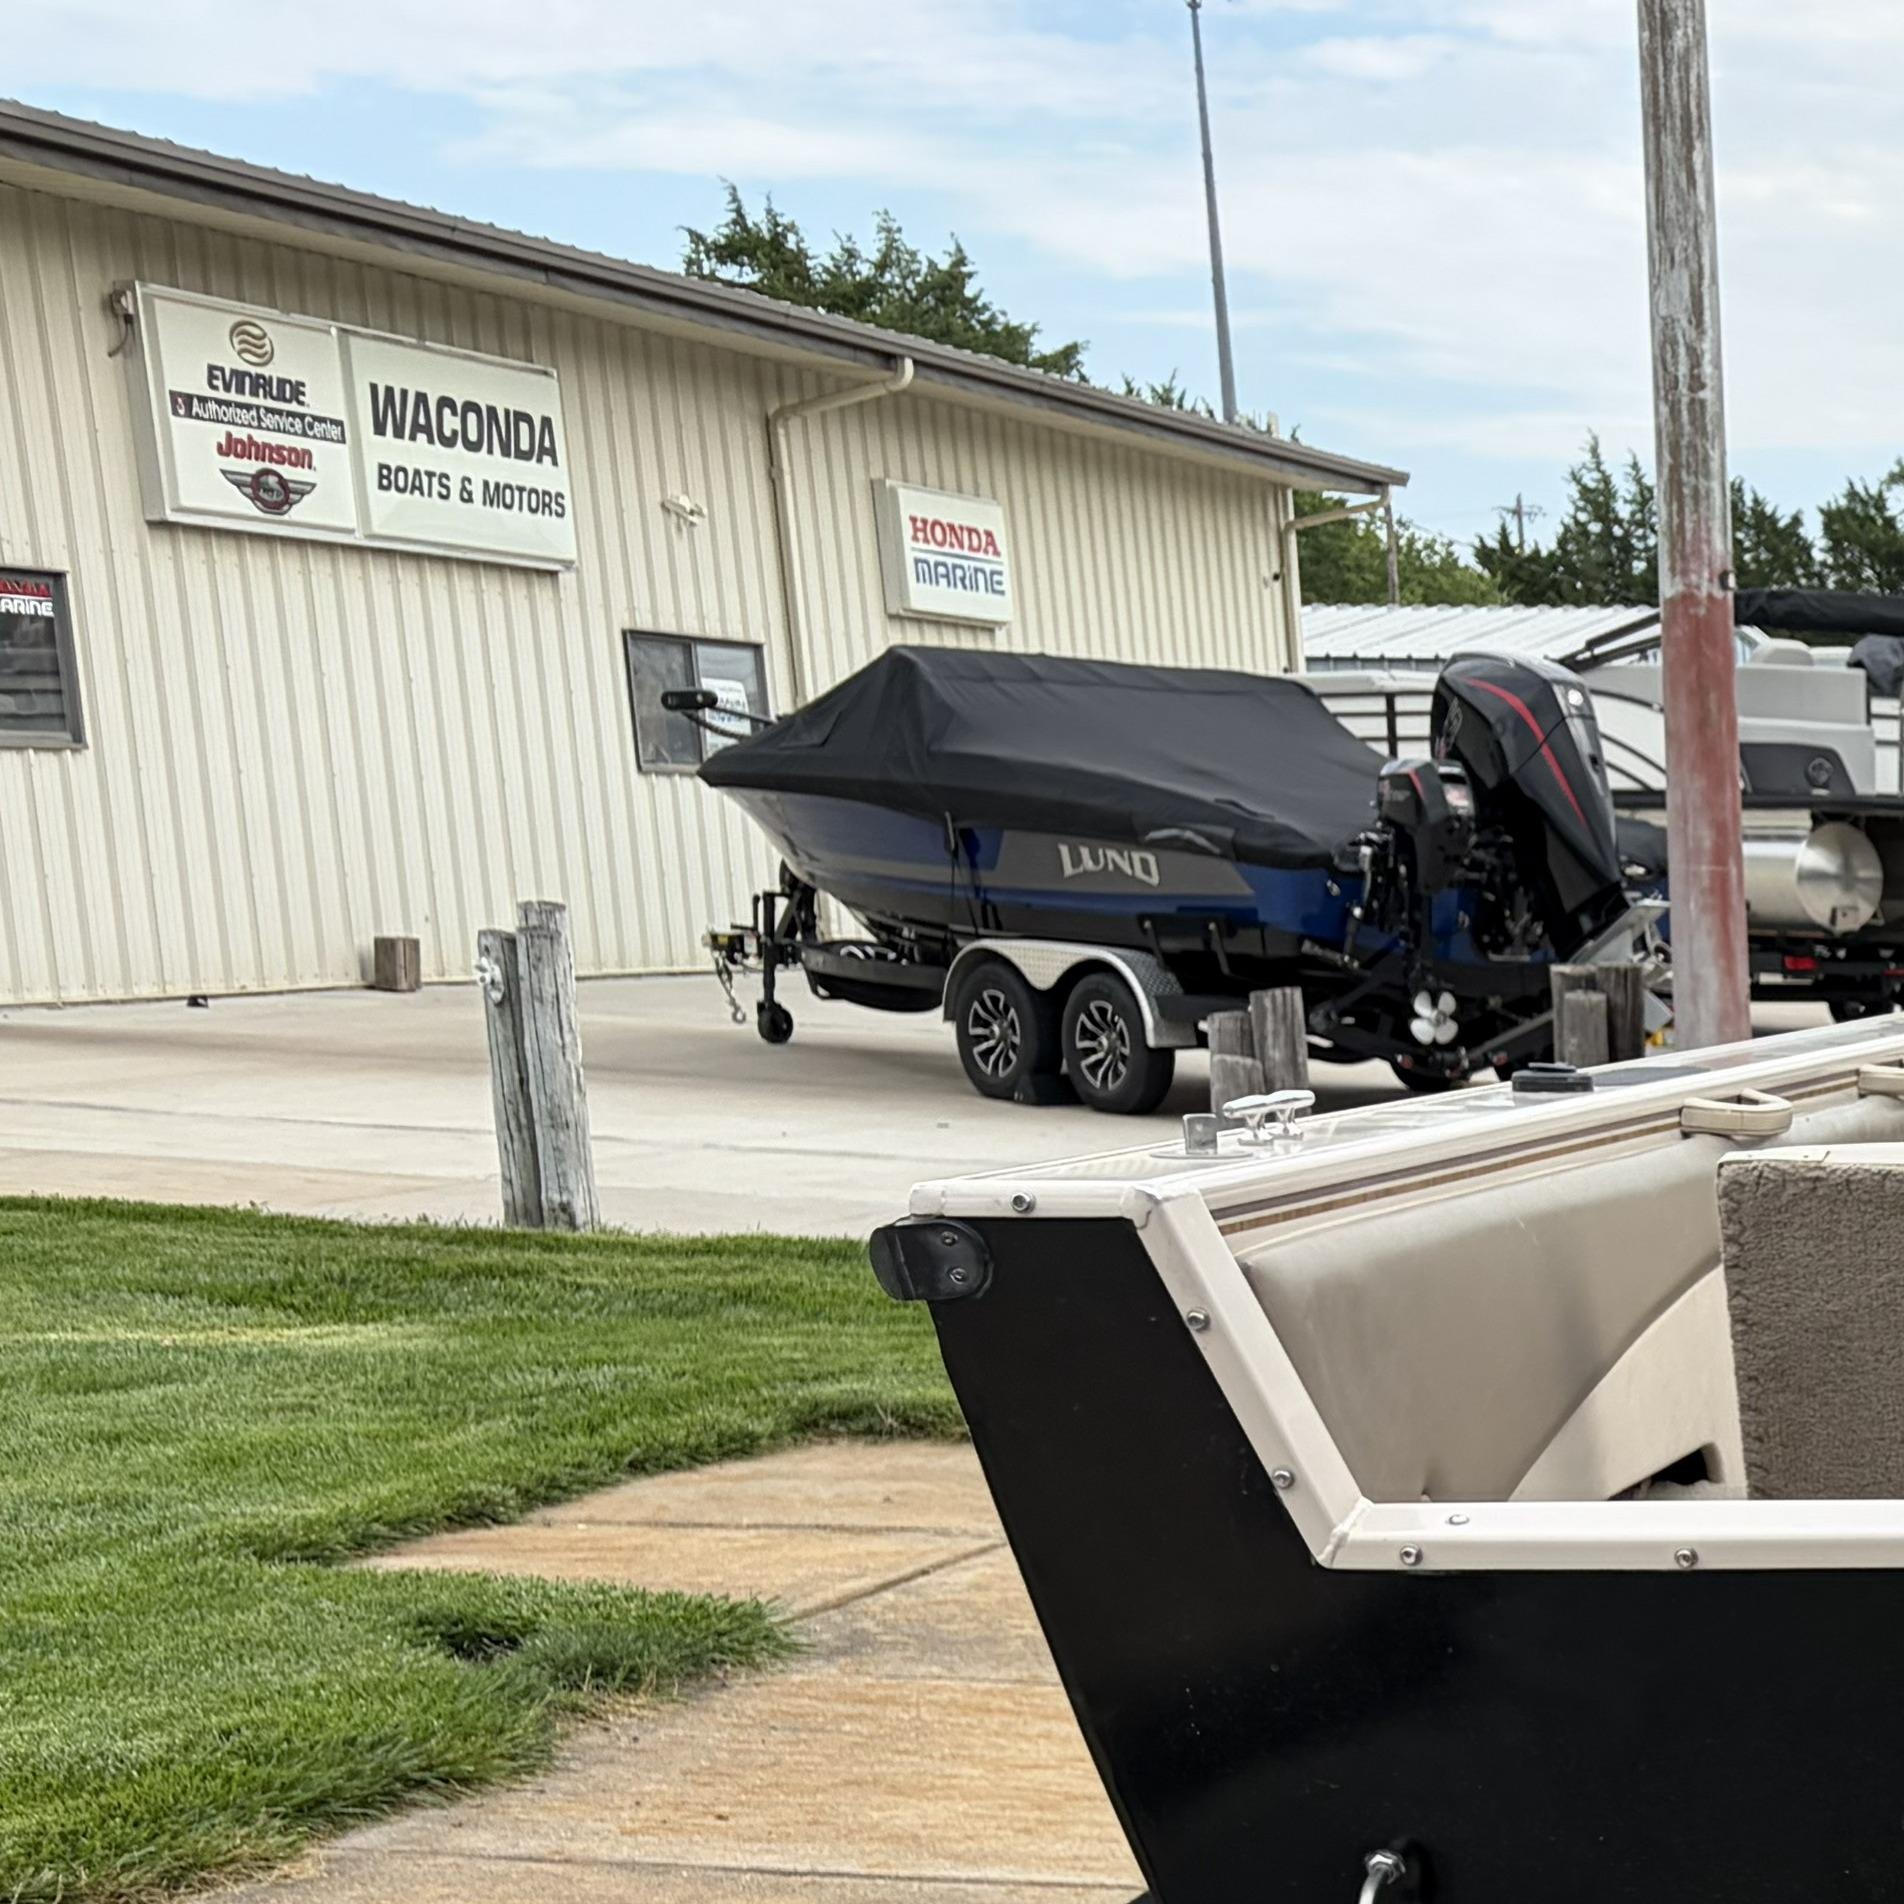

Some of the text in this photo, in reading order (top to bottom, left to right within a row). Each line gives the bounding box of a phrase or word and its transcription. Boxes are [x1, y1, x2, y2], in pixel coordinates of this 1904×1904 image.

[207, 363, 306, 407] EVINRUDE
[191, 397, 343, 442] Authorized Service Center
[369, 381, 559, 467] WACONDA
[216, 430, 313, 470] Johnson
[377, 462, 566, 519] BOATS & MOTORS
[909, 514, 1002, 558] HONDA
[0, 597, 55, 618] ARINE
[1058, 842, 1160, 887] LUND
